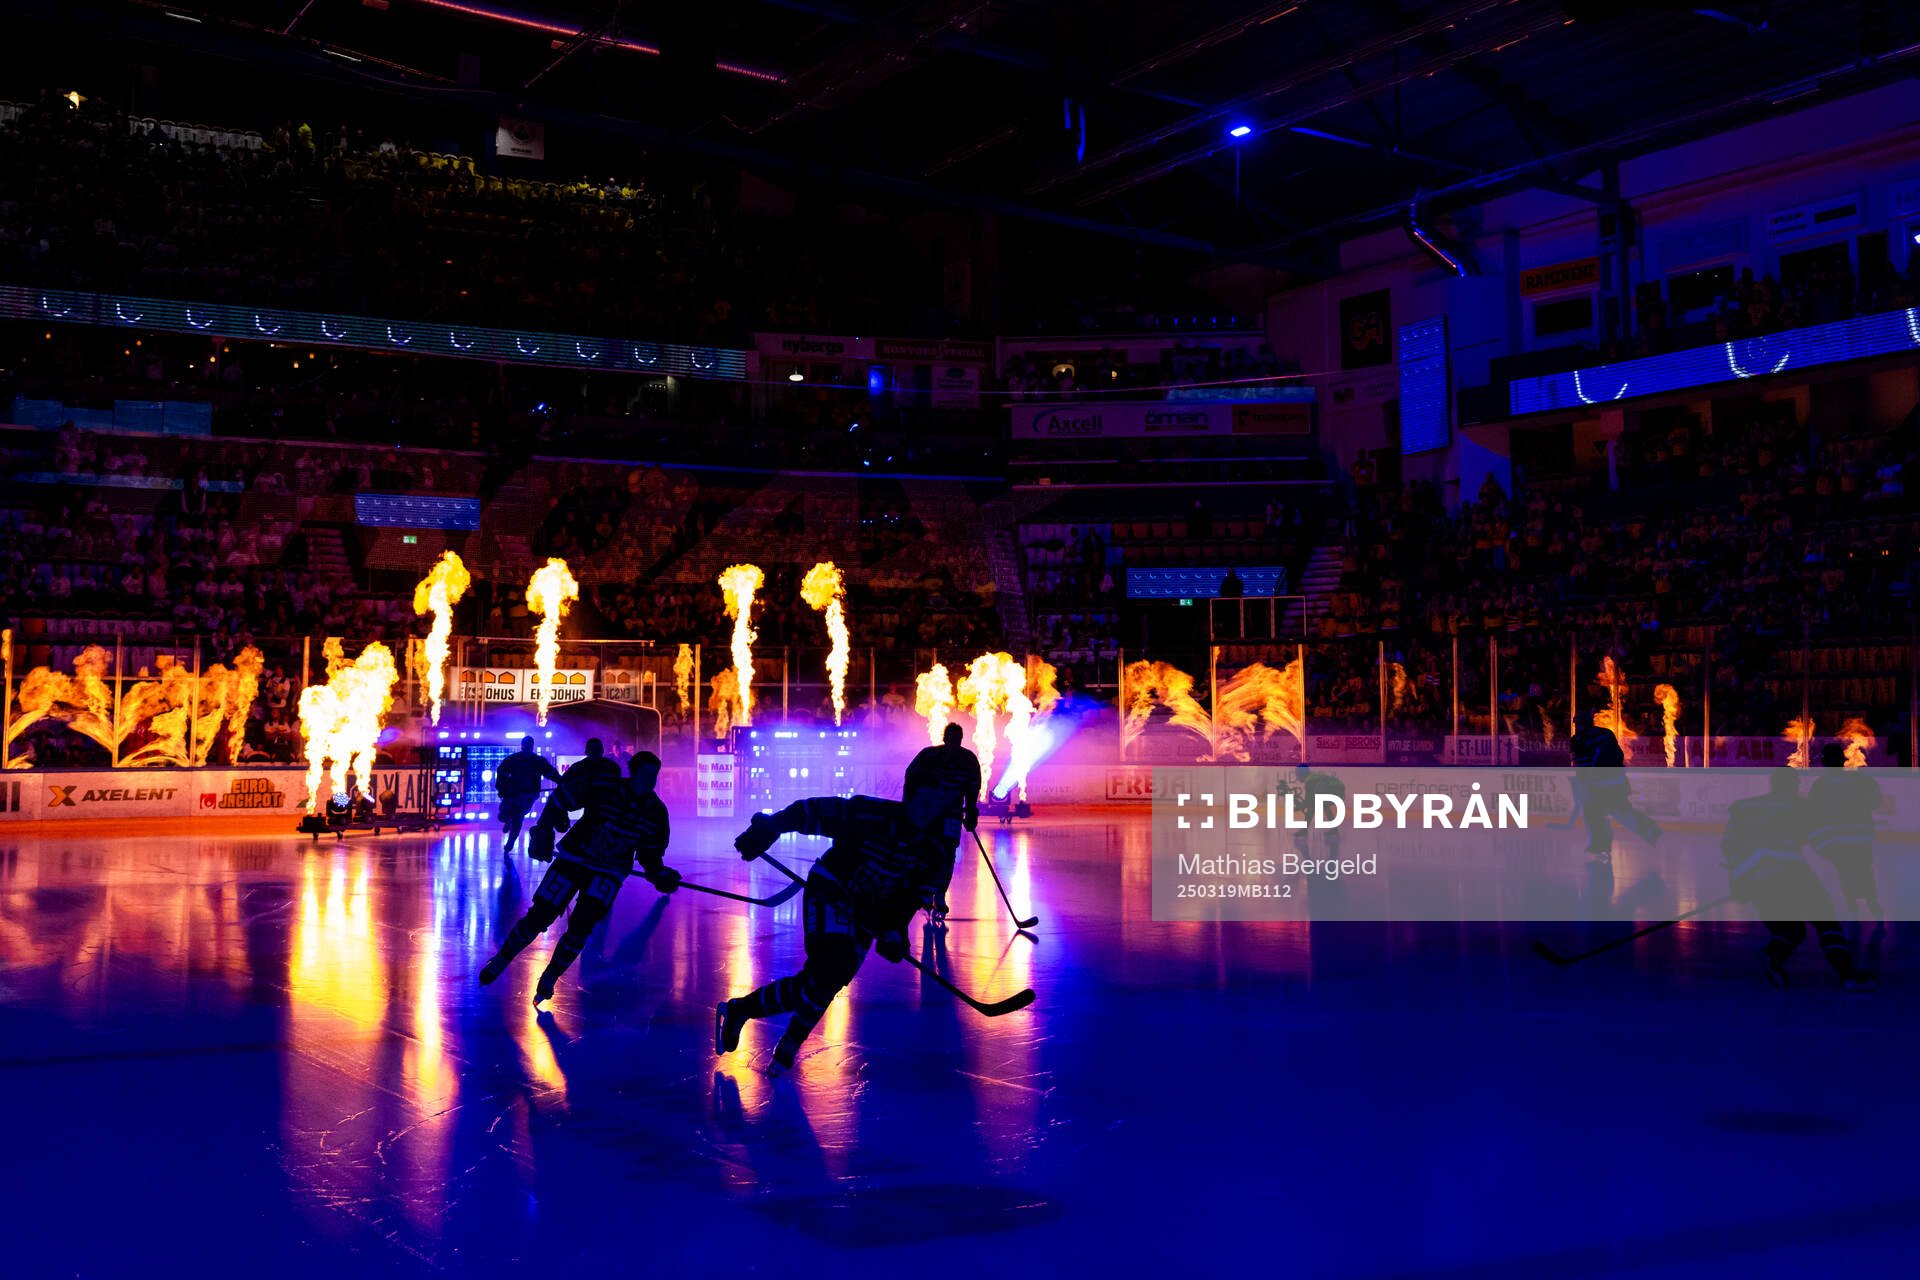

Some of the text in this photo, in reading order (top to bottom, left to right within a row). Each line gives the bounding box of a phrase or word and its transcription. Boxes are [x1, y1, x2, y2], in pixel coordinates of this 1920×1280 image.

[1047, 413, 1103, 433] Axcell
[231, 778, 271, 794] EURO
[1111, 774, 1187, 797] FREJA
[82, 788, 178, 802] AXELENT
[218, 792, 284, 808] JACKPOT
